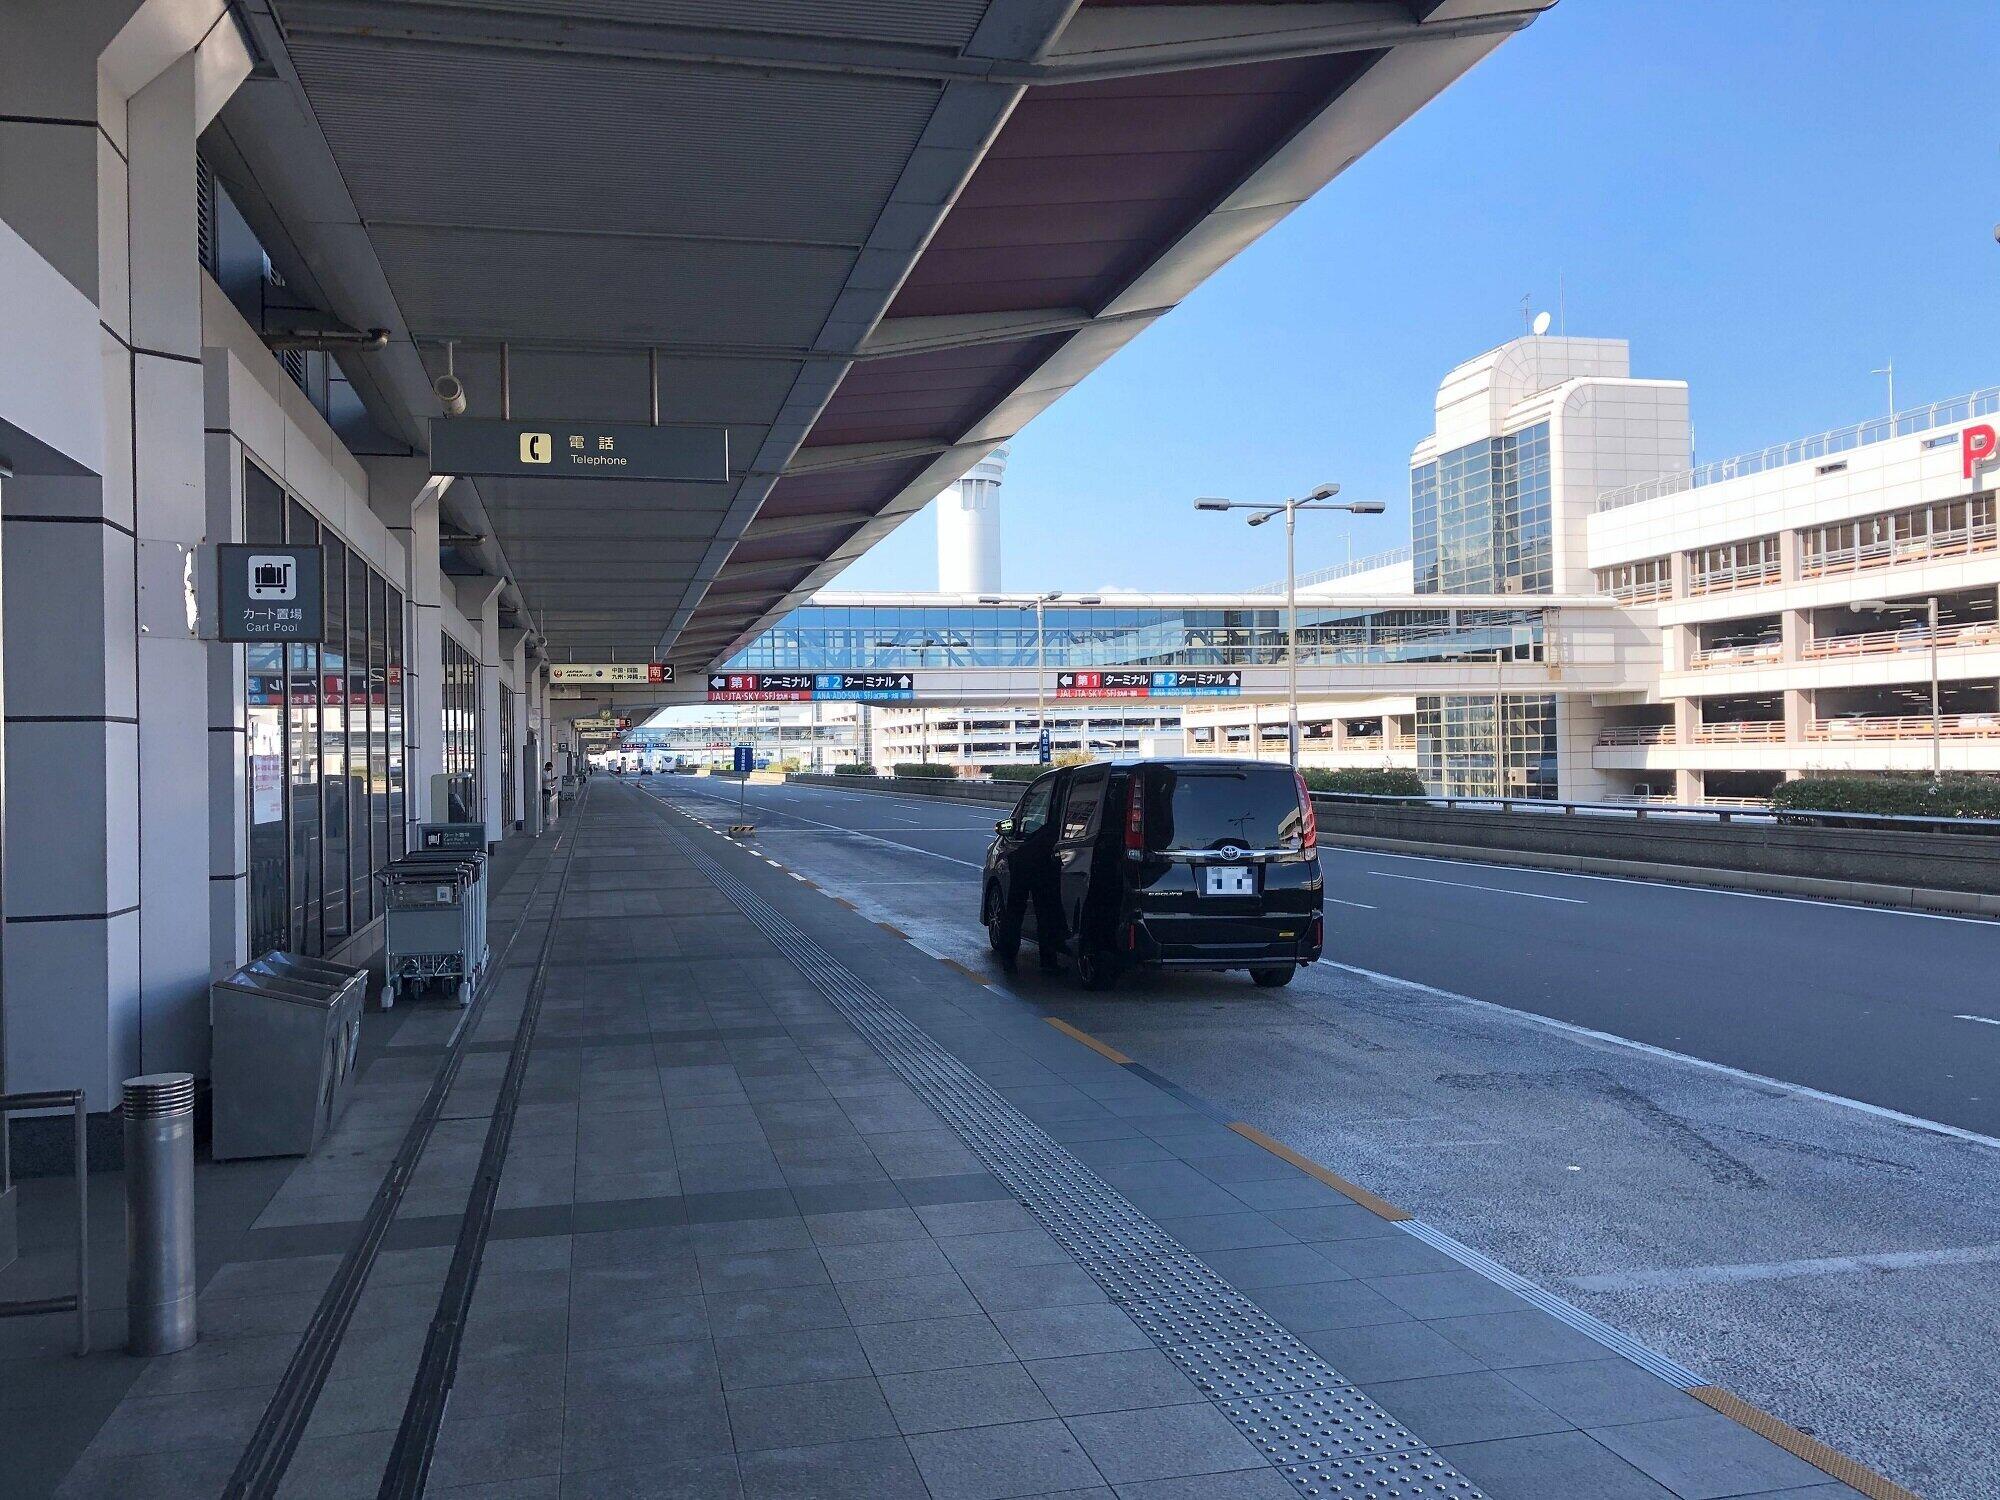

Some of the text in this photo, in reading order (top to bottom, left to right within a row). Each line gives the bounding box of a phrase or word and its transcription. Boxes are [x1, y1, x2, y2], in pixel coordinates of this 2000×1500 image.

[569, 435, 614, 450] 電話
[1962, 424, 1996, 479] P
[571, 454, 627, 466] Telephone
[243, 608, 302, 620] カート置場
[246, 623, 298, 632] Cart Pool
[650, 666, 661, 678] 南
[664, 667, 673, 680] 2
